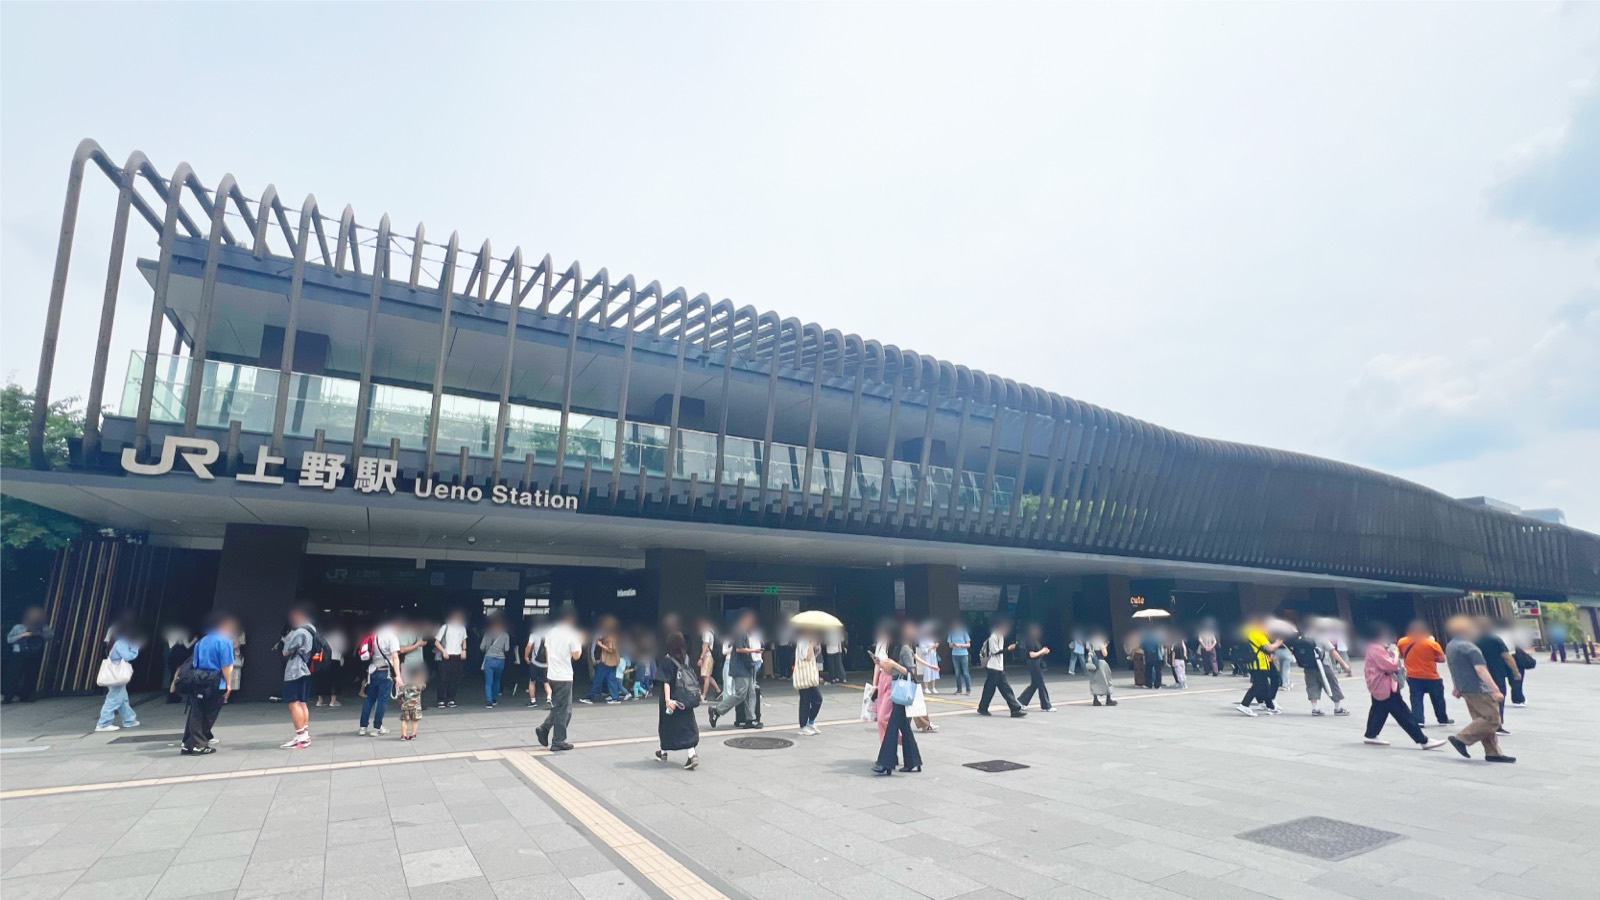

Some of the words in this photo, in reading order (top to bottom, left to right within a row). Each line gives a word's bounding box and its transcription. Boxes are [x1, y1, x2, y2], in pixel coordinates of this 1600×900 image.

[121, 436, 219, 479] JR
[236, 446, 397, 495] 上野駅
[414, 478, 483, 503] Ueno
[491, 484, 579, 510] Station
